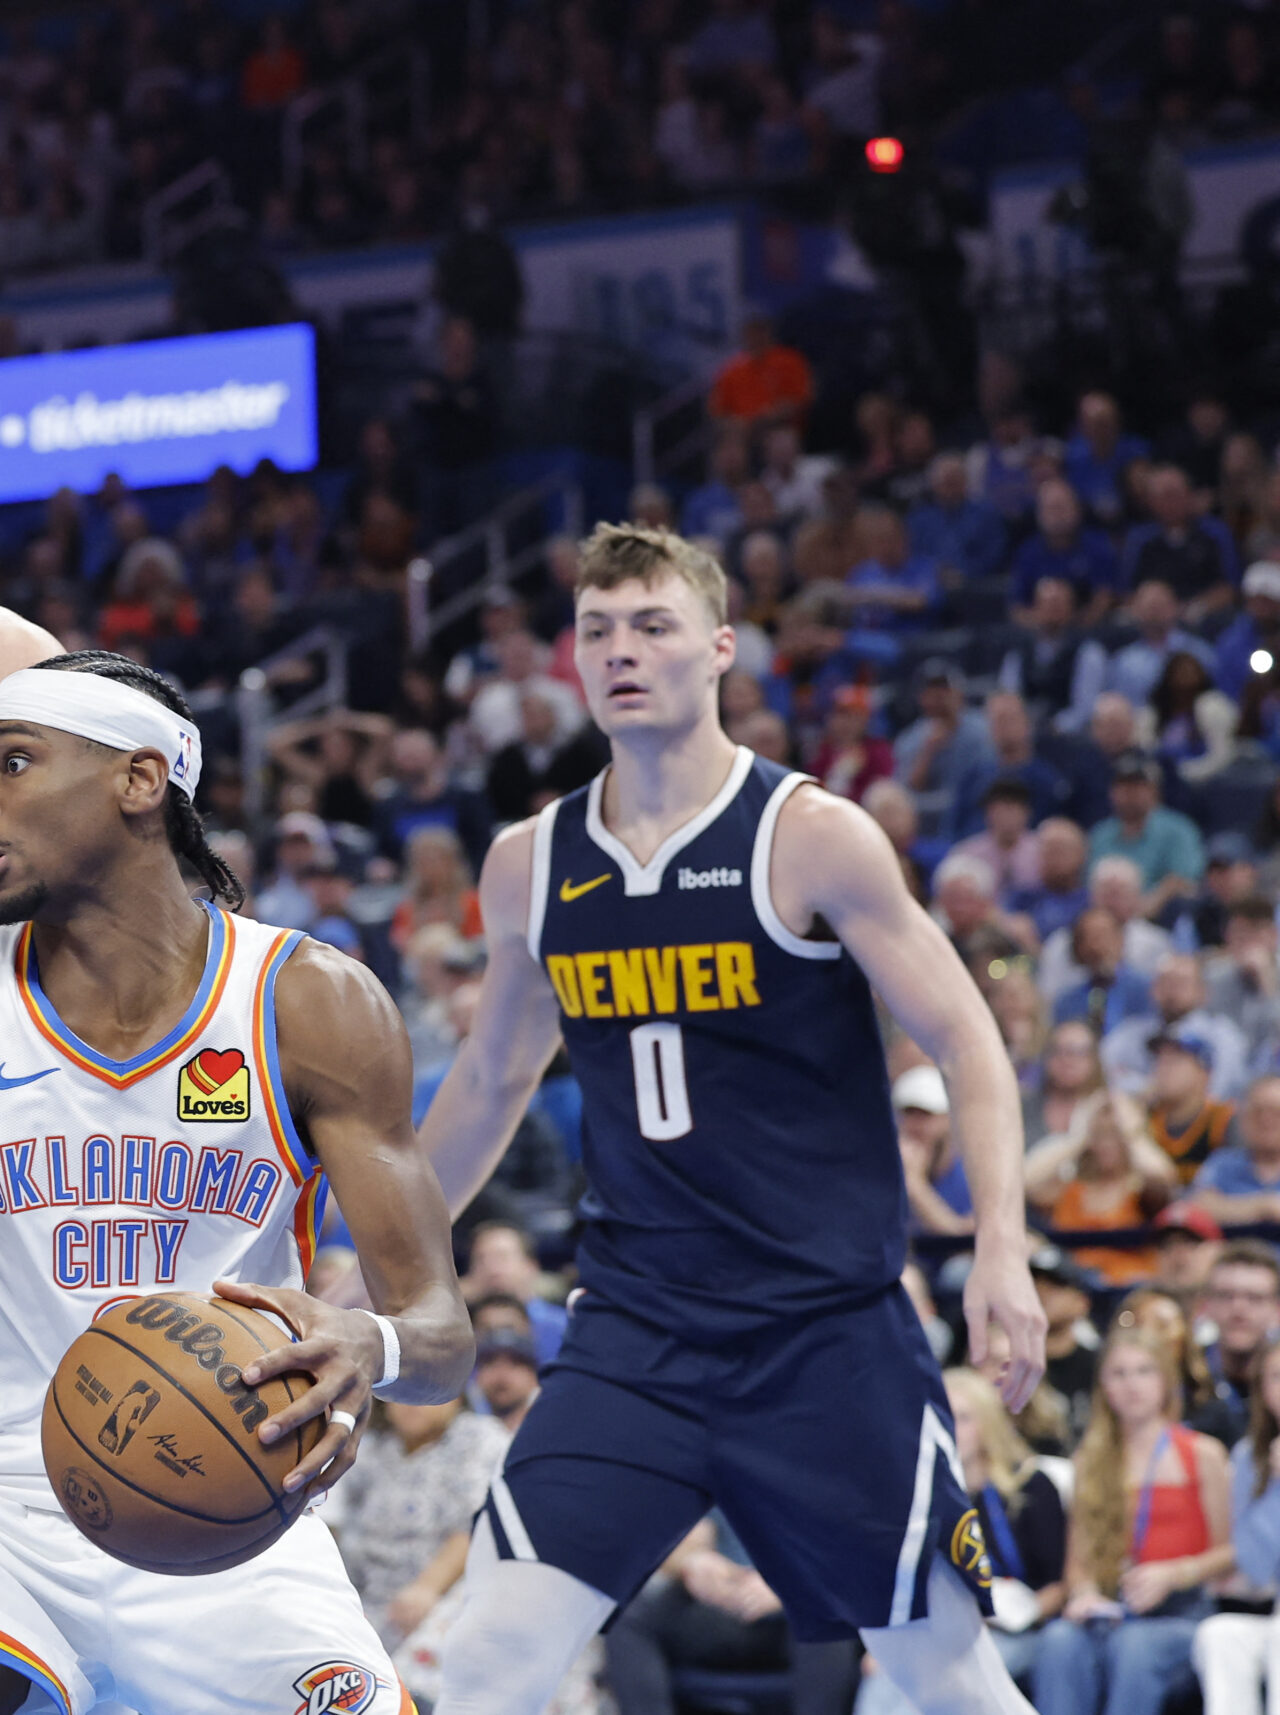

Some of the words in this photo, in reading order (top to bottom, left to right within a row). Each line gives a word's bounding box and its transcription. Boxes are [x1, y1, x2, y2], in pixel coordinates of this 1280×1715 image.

[30, 380, 289, 453] ticketmaster
[678, 866, 742, 890] ibotta
[545, 941, 762, 1018] DENVER
[629, 1021, 693, 1141] 0
[52, 1219, 190, 1290] CITY
[125, 1297, 269, 1433] Wilson
